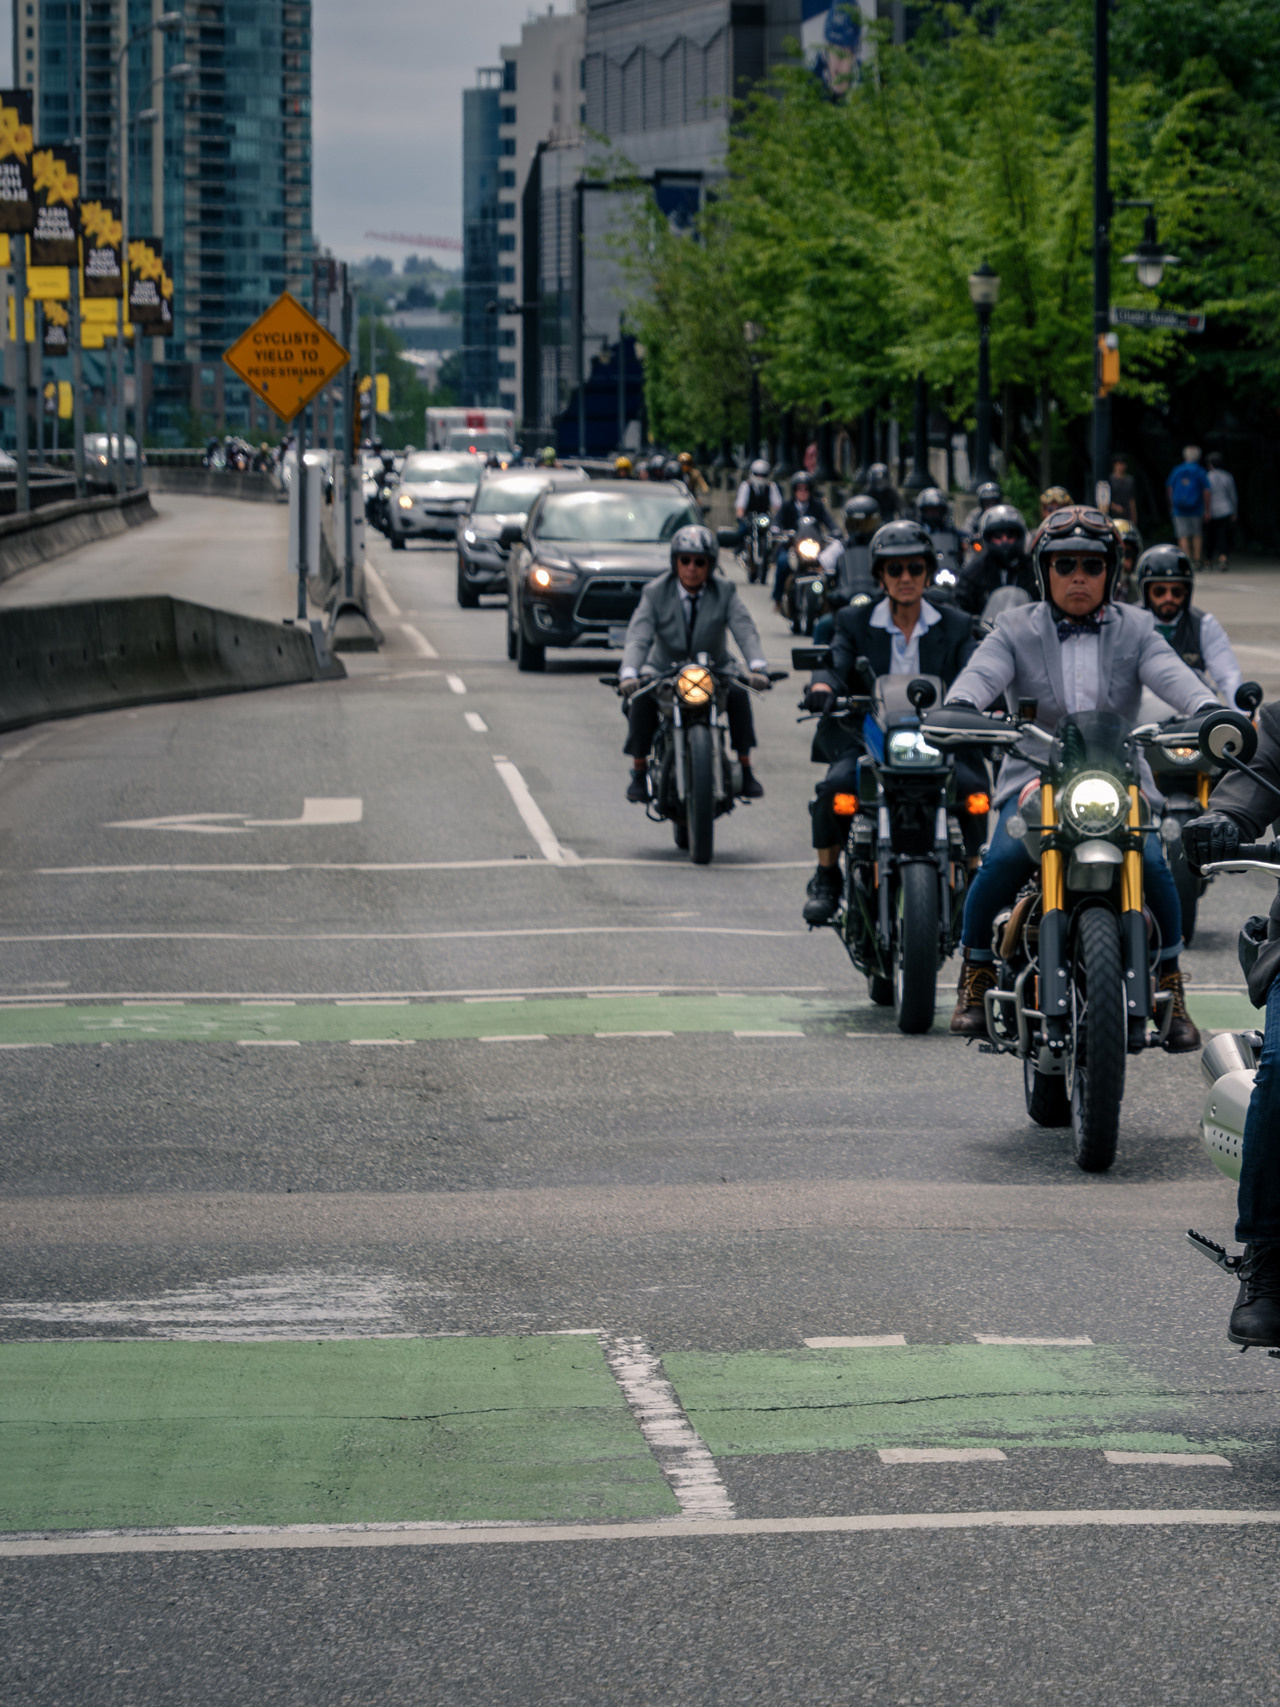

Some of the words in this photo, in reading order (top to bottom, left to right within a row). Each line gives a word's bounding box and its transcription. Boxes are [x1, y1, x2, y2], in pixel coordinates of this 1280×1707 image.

[253, 331, 321, 345] CYCLISTS
[255, 349, 294, 362] YIELD
[300, 349, 319, 362] TO
[247, 366, 326, 378] PEDESTRIANS
